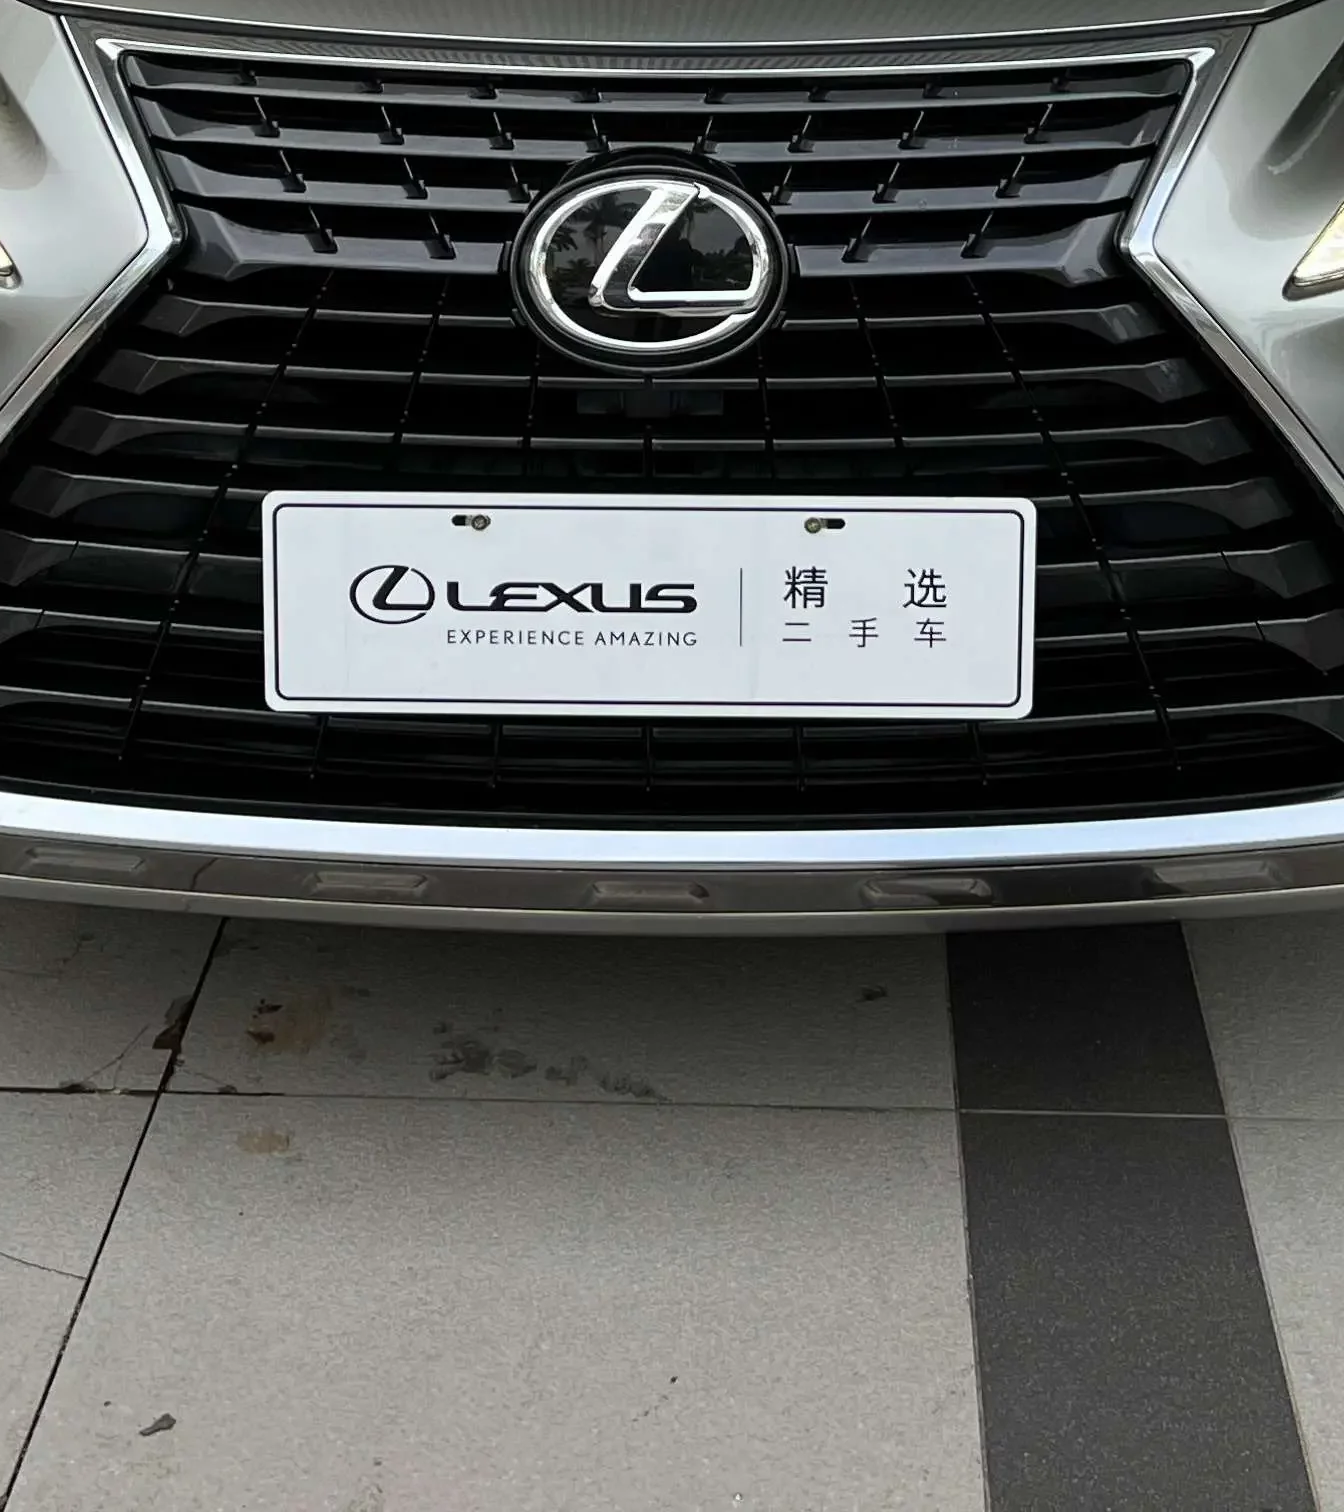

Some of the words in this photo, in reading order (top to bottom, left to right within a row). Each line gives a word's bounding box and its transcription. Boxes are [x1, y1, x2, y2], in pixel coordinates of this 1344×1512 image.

[447, 581, 697, 614] LEXUS
[783, 567, 948, 610] 精选
[447, 629, 585, 647] EXPERIENCE
[594, 631, 698, 648] AMAZING
[782, 618, 948, 650] 二手车
